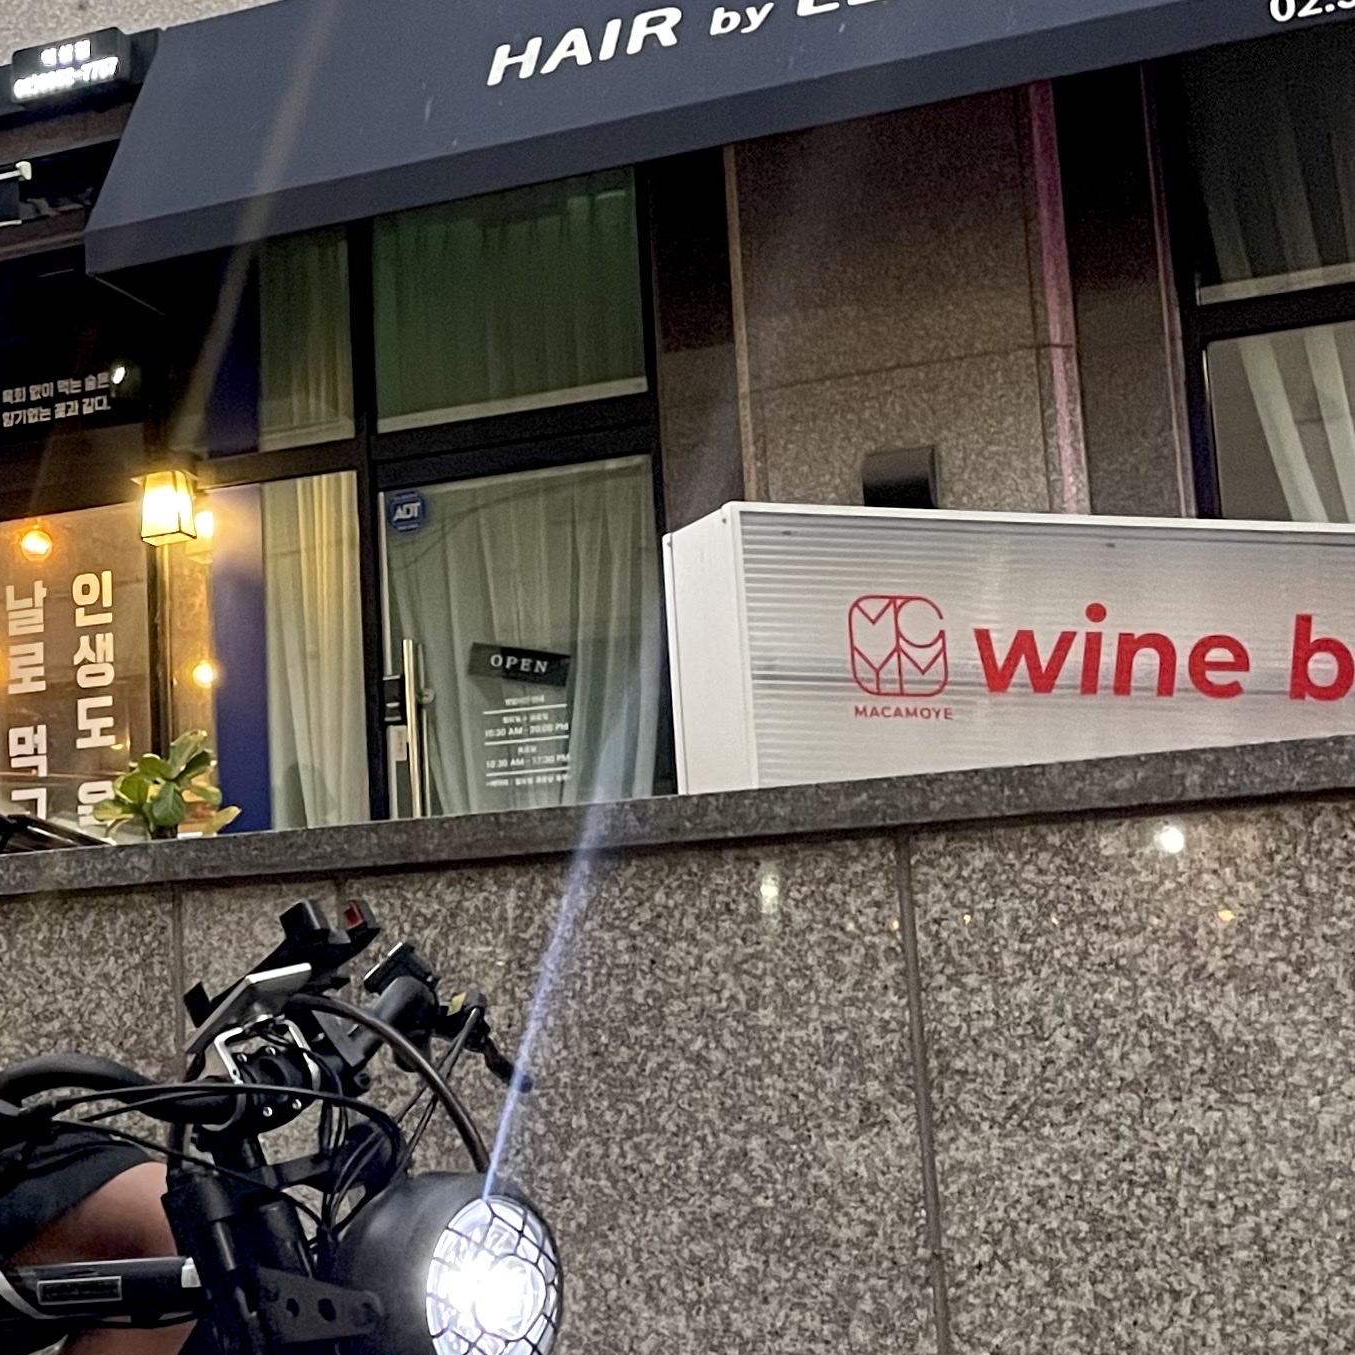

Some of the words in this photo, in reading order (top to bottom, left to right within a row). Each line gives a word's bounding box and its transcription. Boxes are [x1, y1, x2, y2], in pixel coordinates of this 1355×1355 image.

[486, 6, 683, 86] HAIR
[710, 2, 774, 36] by
[392, 502, 421, 521] ADT
[5, 580, 47, 695] 날로
[71, 570, 116, 749] 인생도
[490, 654, 549, 673] OPEN
[973, 602, 1251, 699] wine
[854, 705, 953, 720] MACAMOYE
